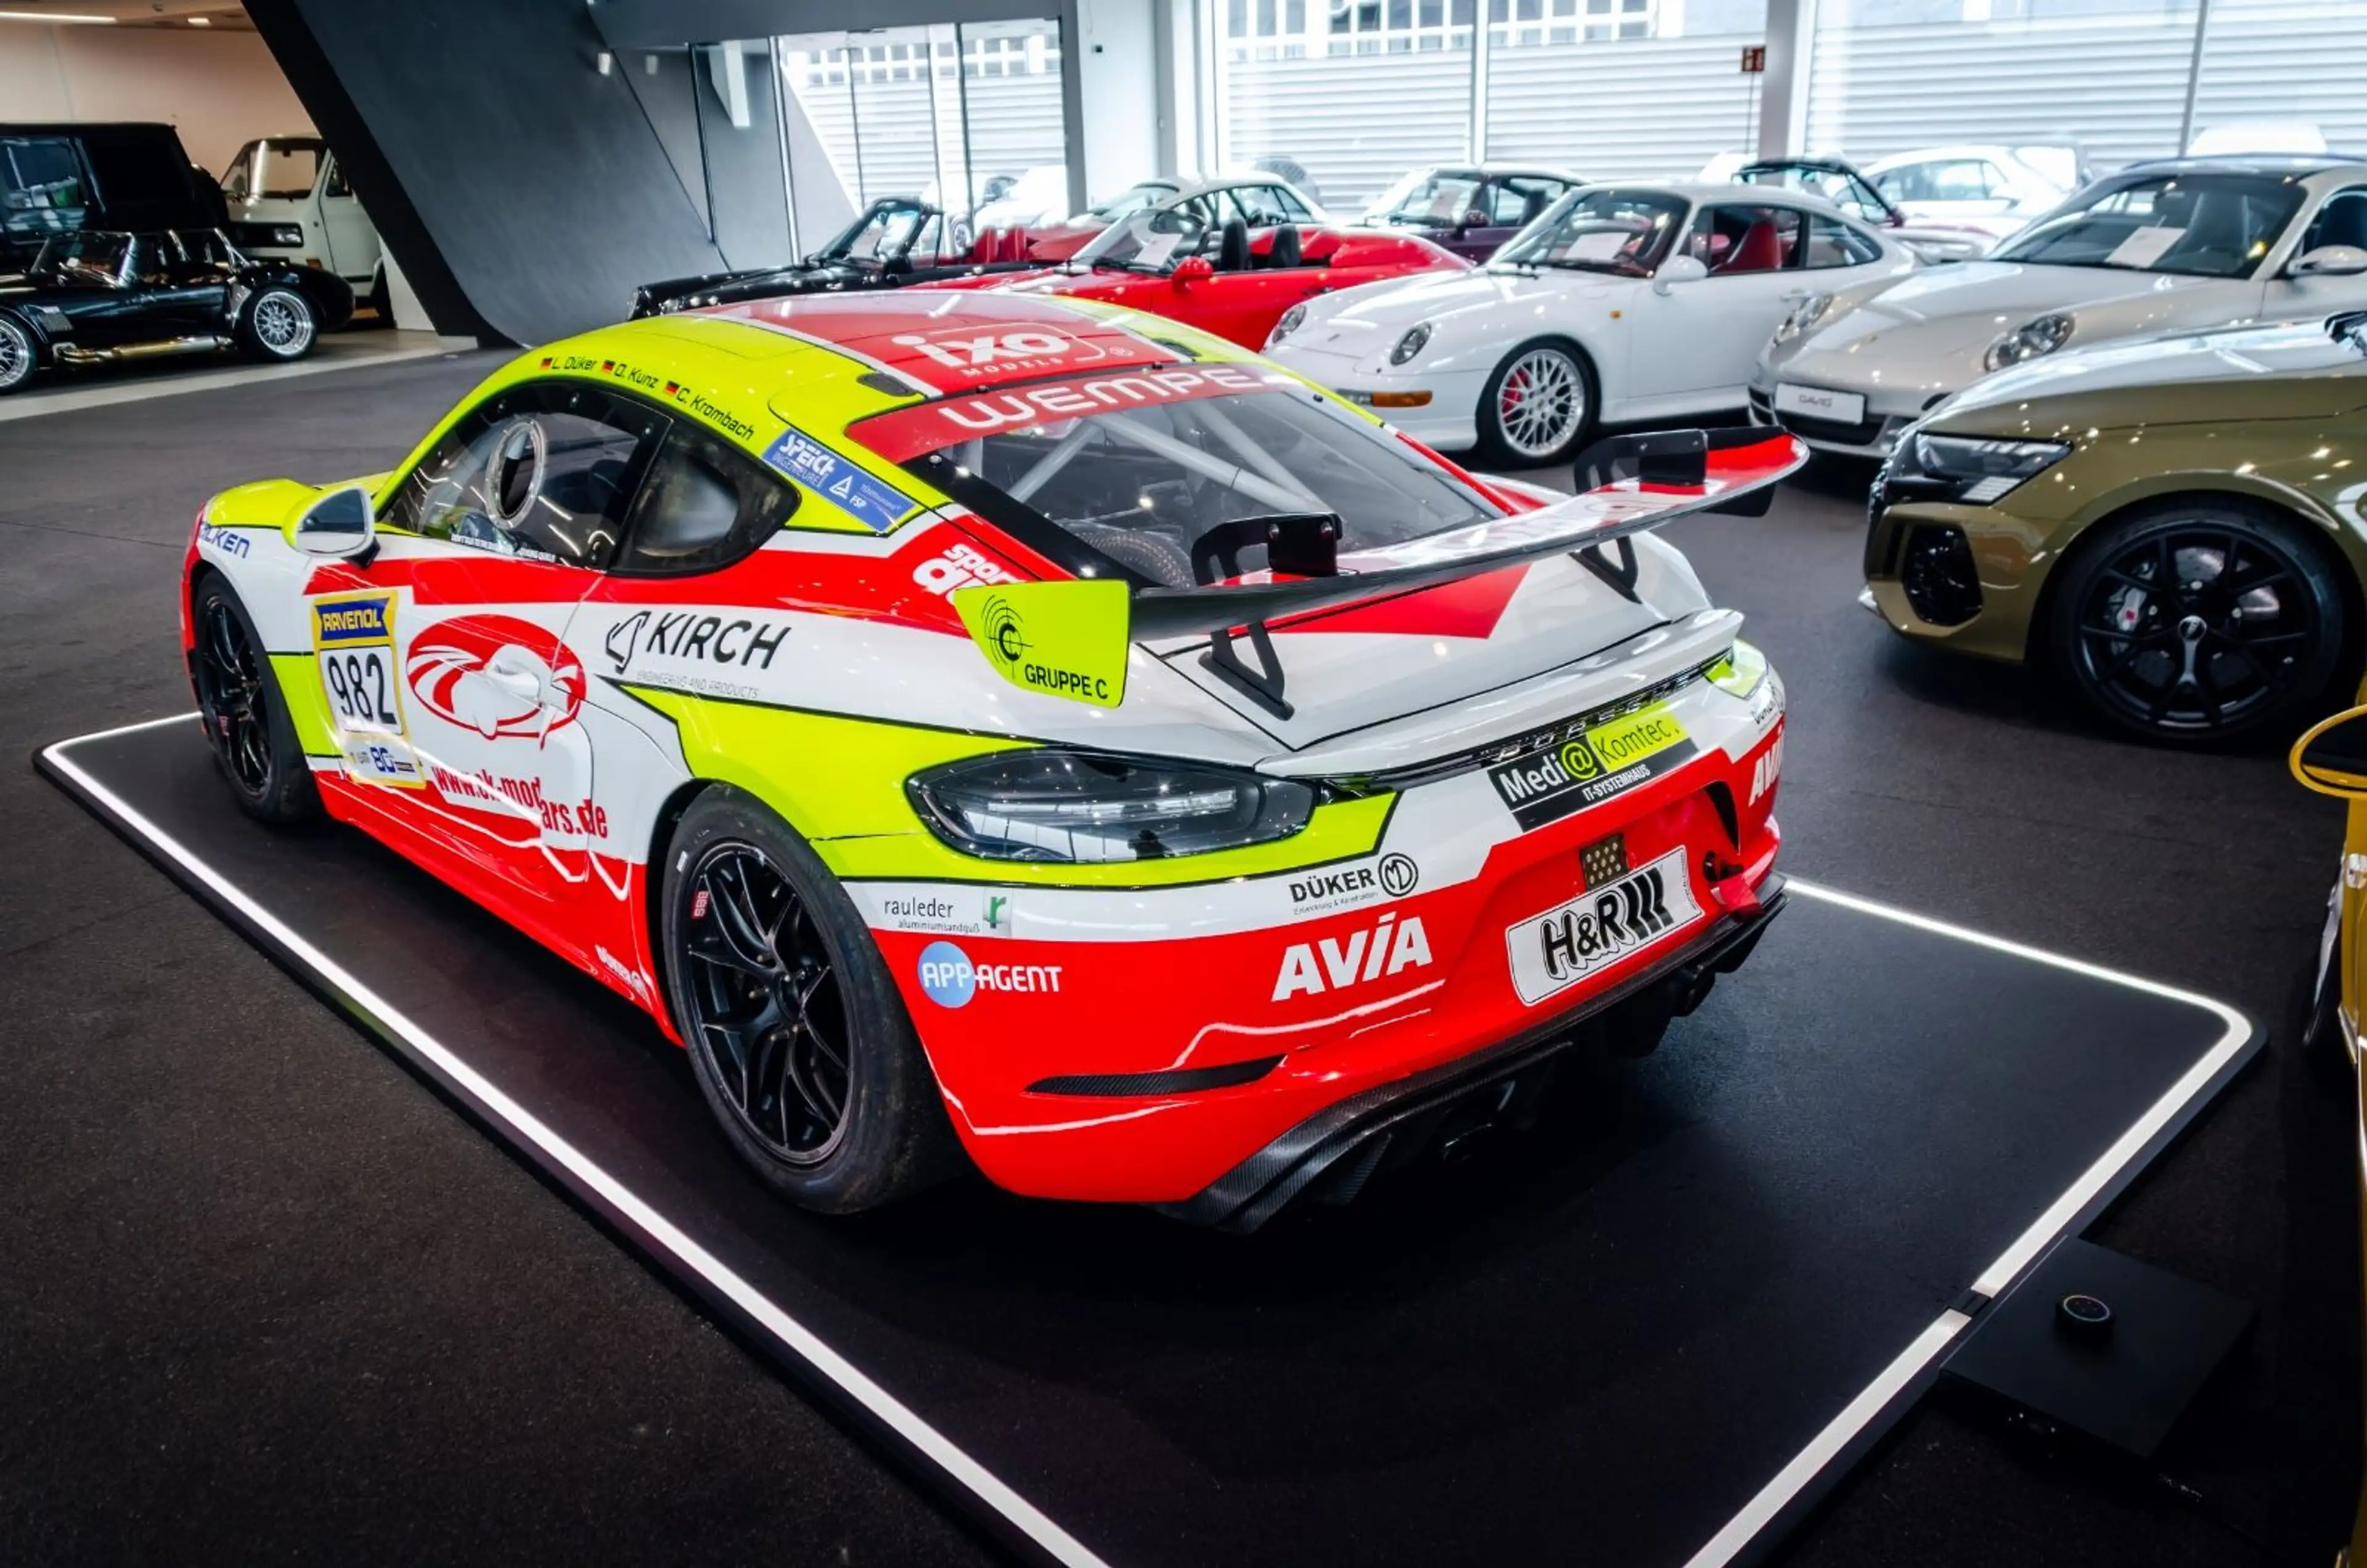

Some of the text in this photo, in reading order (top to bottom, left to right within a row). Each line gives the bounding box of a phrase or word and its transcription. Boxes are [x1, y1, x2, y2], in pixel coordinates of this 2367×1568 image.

[563, 356, 598, 370] Düker
[628, 367, 660, 389] Kunz
[961, 357, 1064, 377] MODELS
[938, 367, 1264, 428] WEMPE
[690, 394, 755, 441] Krombach
[942, 544, 1026, 585] spor
[322, 608, 382, 632] RAVENOL
[645, 612, 793, 670] KIRCH
[327, 652, 398, 725] 982
[1024, 664, 1108, 700] GRUPPE C
[1582, 763, 1651, 801] IT-SYSTEMHAUS
[1289, 868, 1376, 904] DÜKER
[884, 896, 954, 918] rauleder
